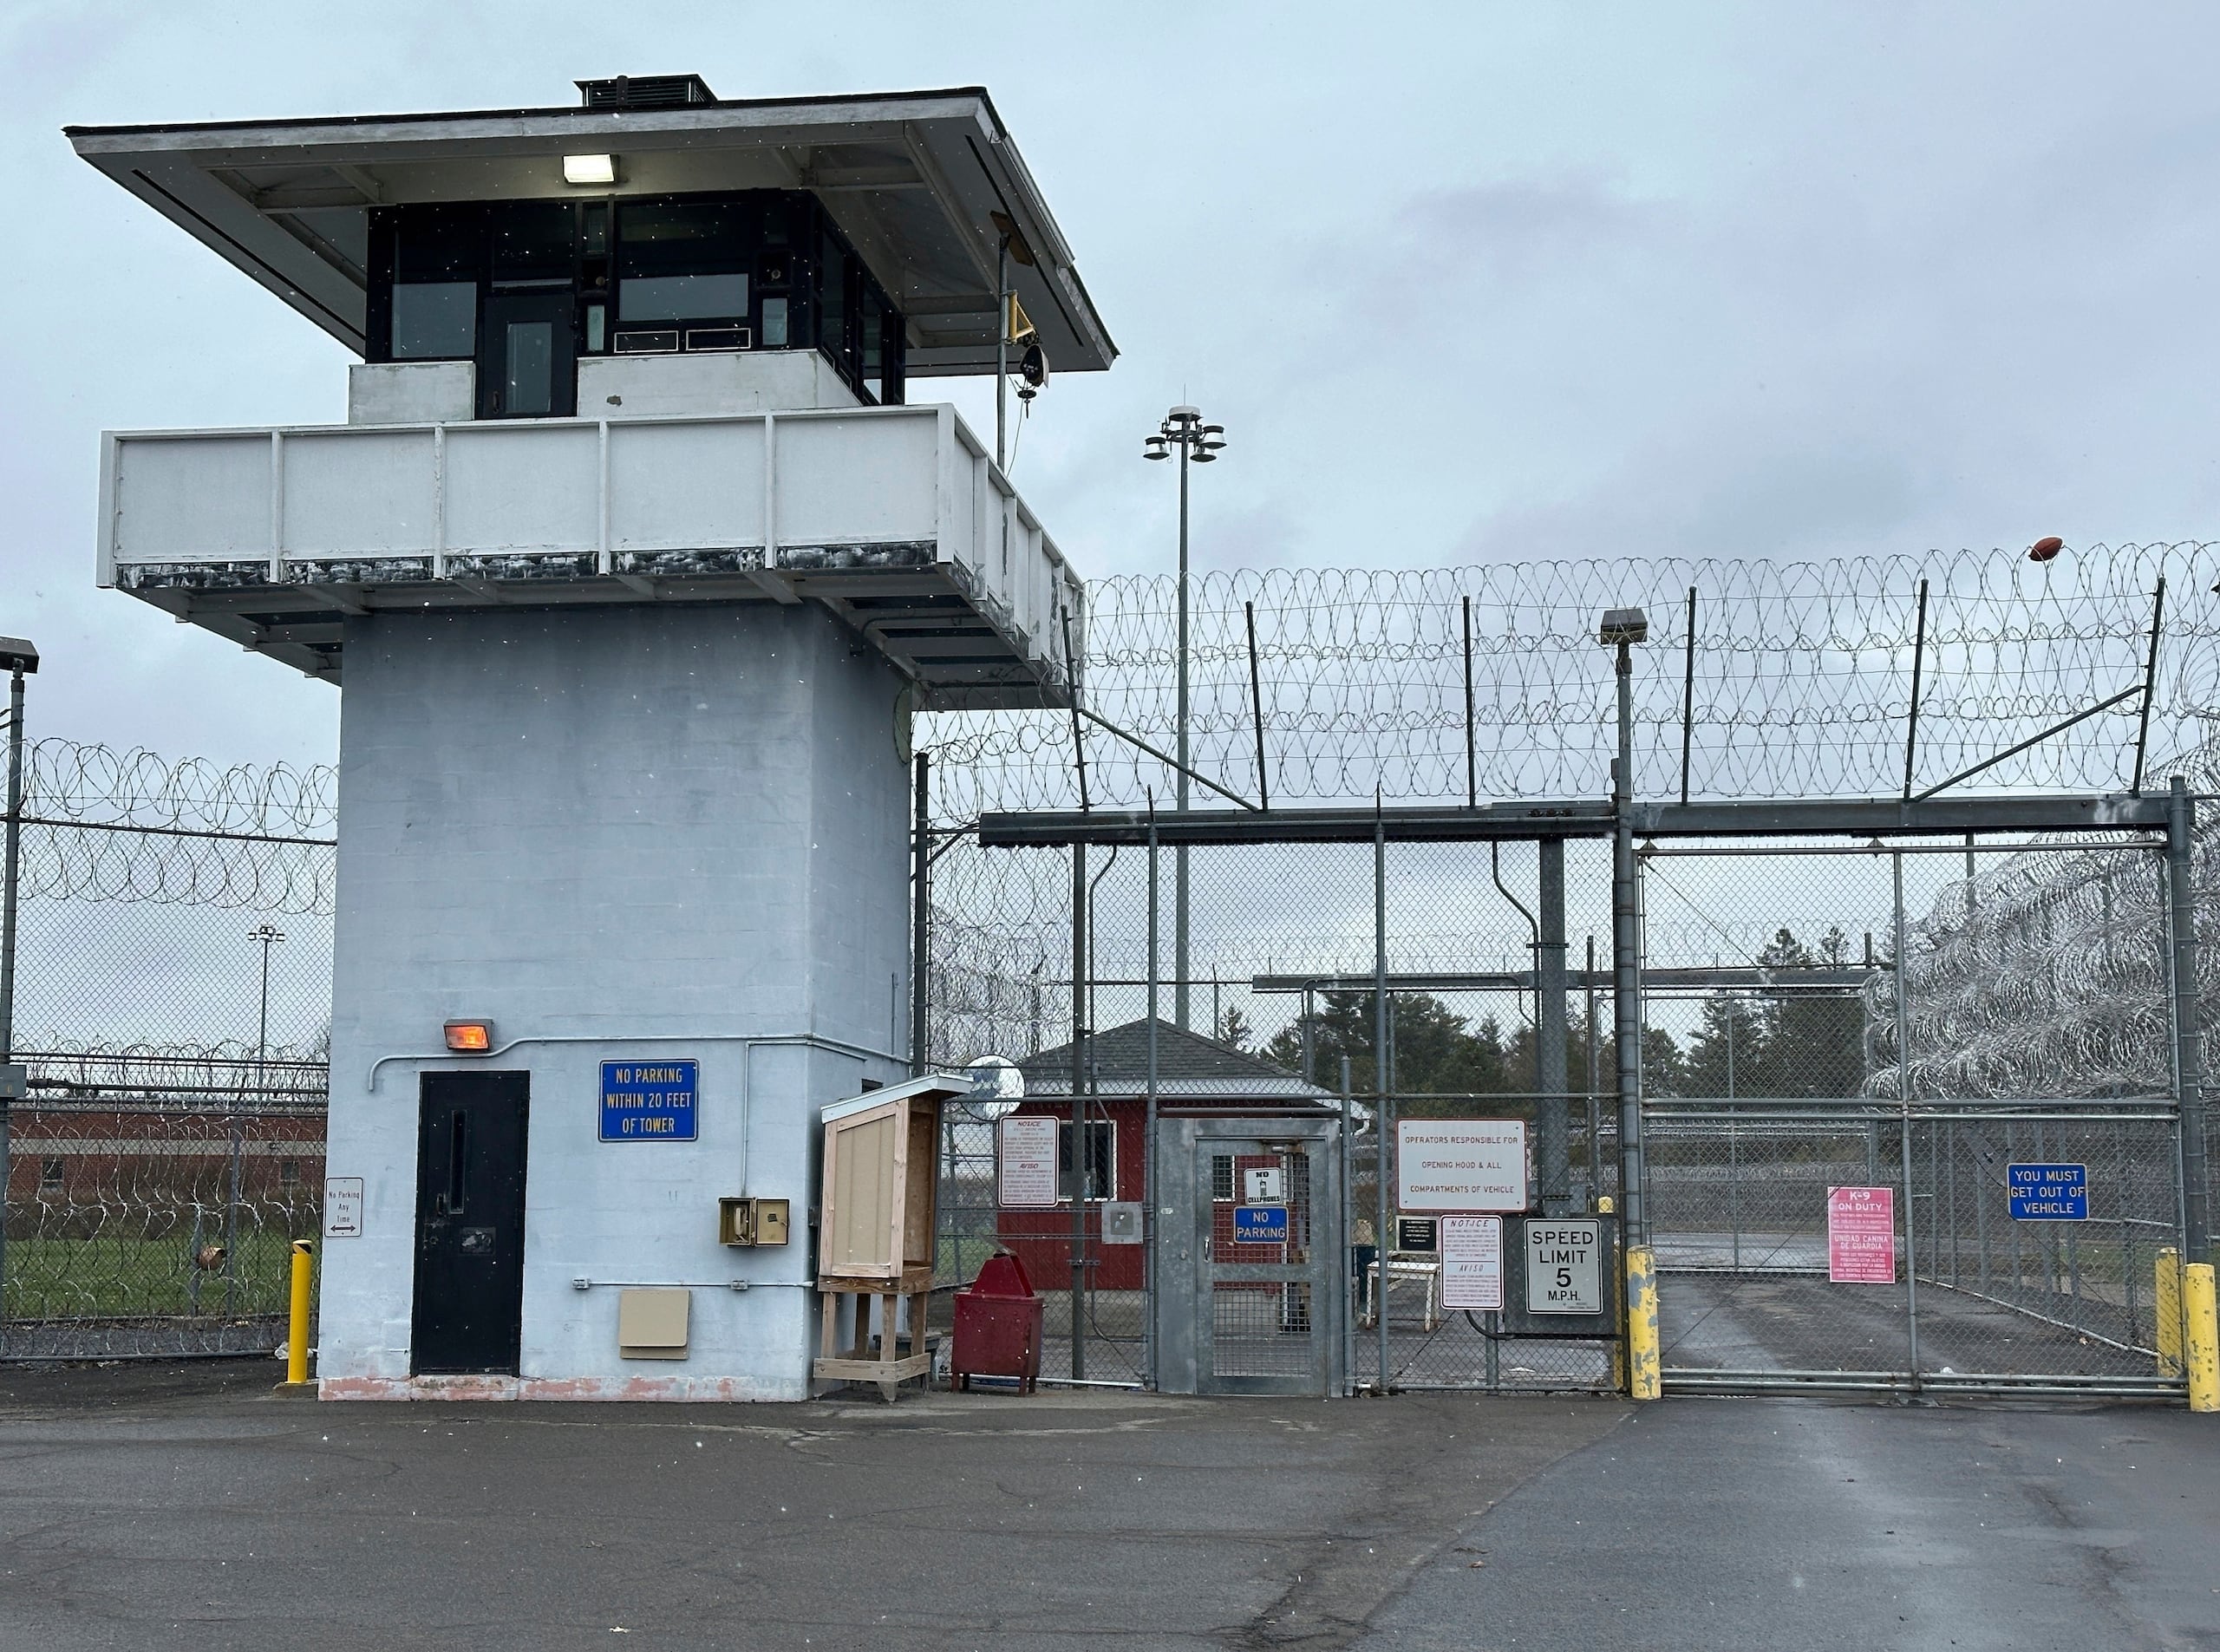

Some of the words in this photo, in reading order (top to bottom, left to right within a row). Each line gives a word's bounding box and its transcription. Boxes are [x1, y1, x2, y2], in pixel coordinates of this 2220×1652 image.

[616, 1068, 630, 1083] NO
[636, 1068, 682, 1083] PARKING
[606, 1093, 643, 1108] WITHIN
[649, 1093, 662, 1108] 20
[667, 1093, 691, 1107] FEET
[623, 1118, 638, 1134] OF
[640, 1118, 675, 1133] TOWER
[2015, 1171, 2040, 1181] YOU
[2047, 1171, 2079, 1181] MUST
[338, 1192, 360, 1200] Parking
[1850, 1192, 1871, 1200] K-9
[2011, 1186, 2033, 1197] GET
[2039, 1186, 2063, 1197] OUT
[2069, 1186, 2085, 1197] OF
[338, 1204, 349, 1212] Any
[2023, 1203, 2074, 1214] VEHICLE
[1253, 1212, 1269, 1223] NO
[1237, 1227, 1285, 1238] PARKING
[1532, 1231, 1594, 1244] SPEED
[1540, 1250, 1586, 1263] LIMIT
[1556, 1268, 1571, 1288] 5
[1548, 1290, 1581, 1301] M.P.H.
